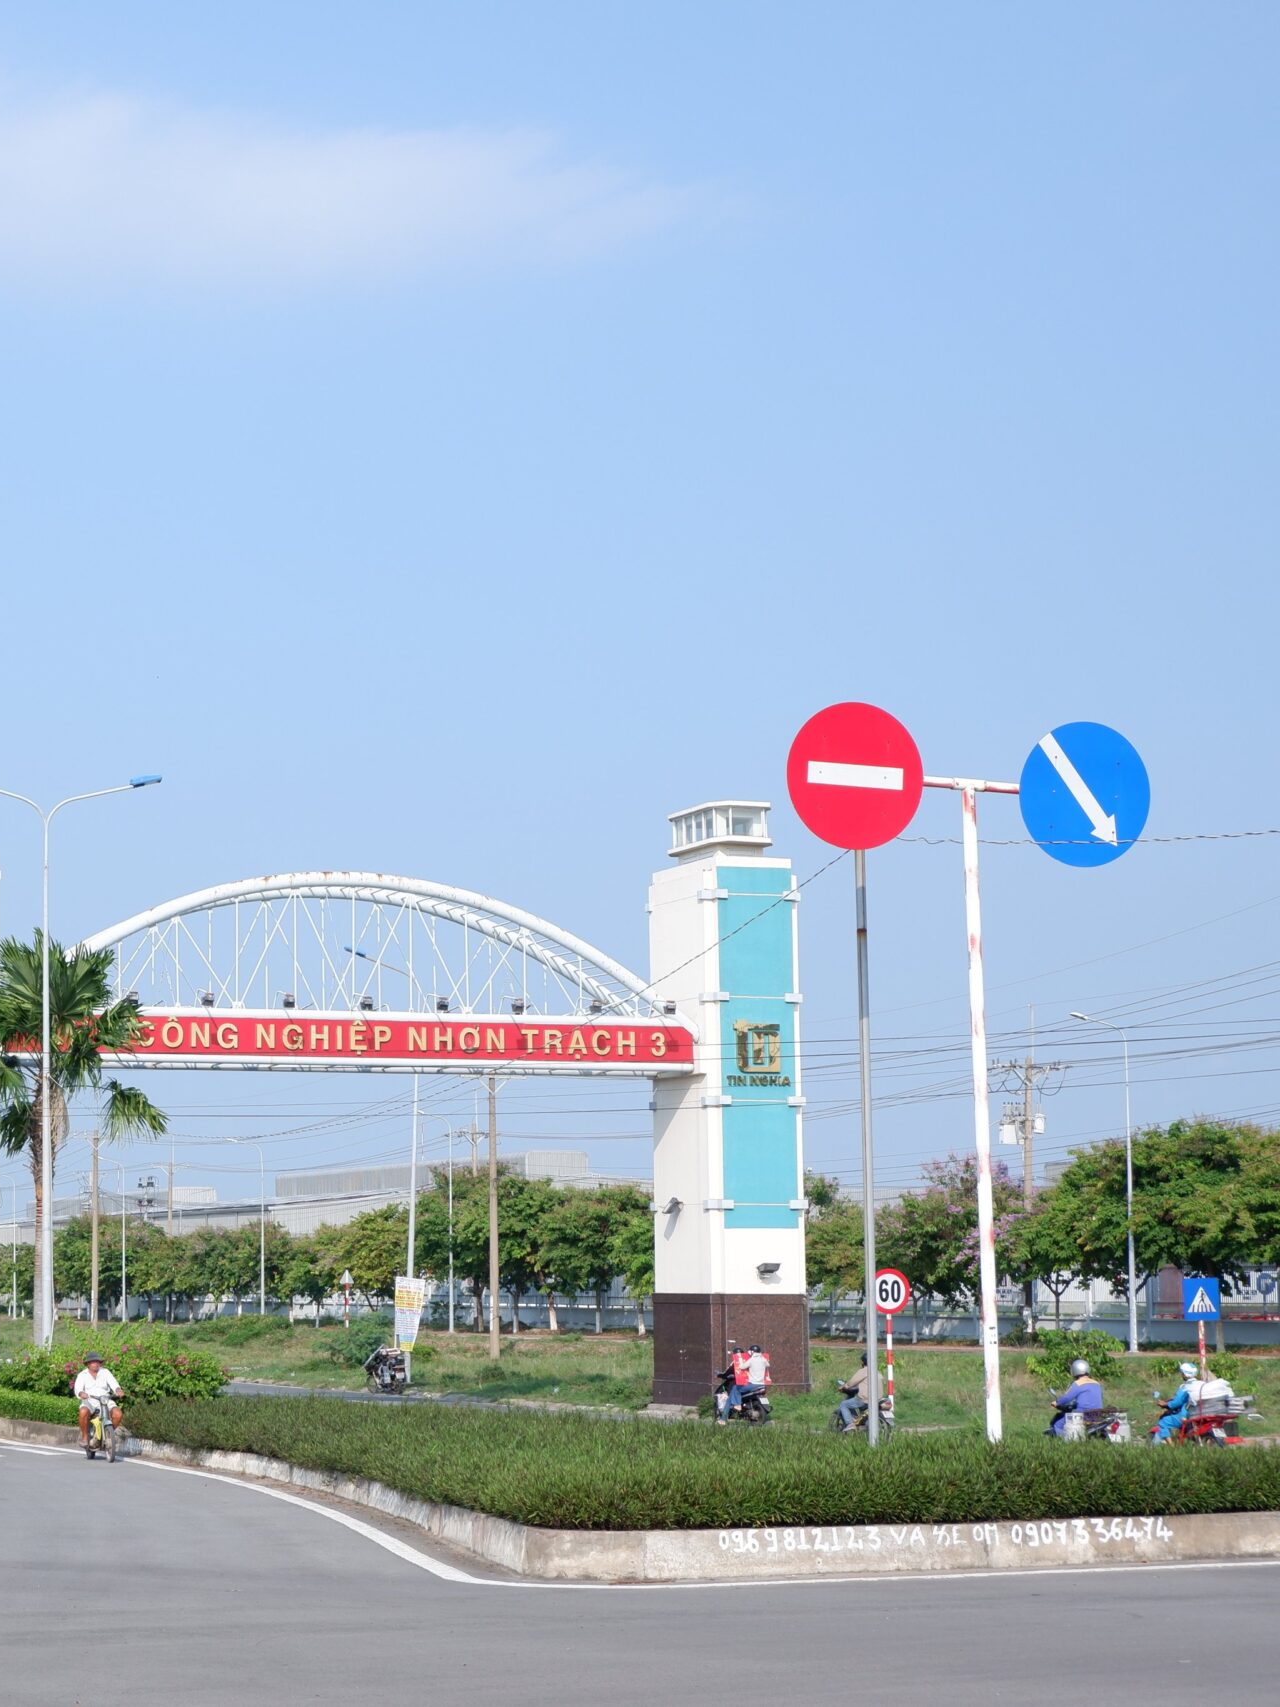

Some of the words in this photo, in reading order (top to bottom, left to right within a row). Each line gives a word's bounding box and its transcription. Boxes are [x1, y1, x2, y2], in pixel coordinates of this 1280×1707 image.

[136, 1016, 240, 1049] CÔNG
[256, 1019, 392, 1056] NGHIỆP
[408, 1025, 505, 1055] NHƠN
[522, 1029, 636, 1060] TRẠCH
[651, 1034, 666, 1056] 3
[878, 1279, 901, 1303] 60
[718, 1526, 882, 1553] 0969812123
[890, 1526, 926, 1546] VA
